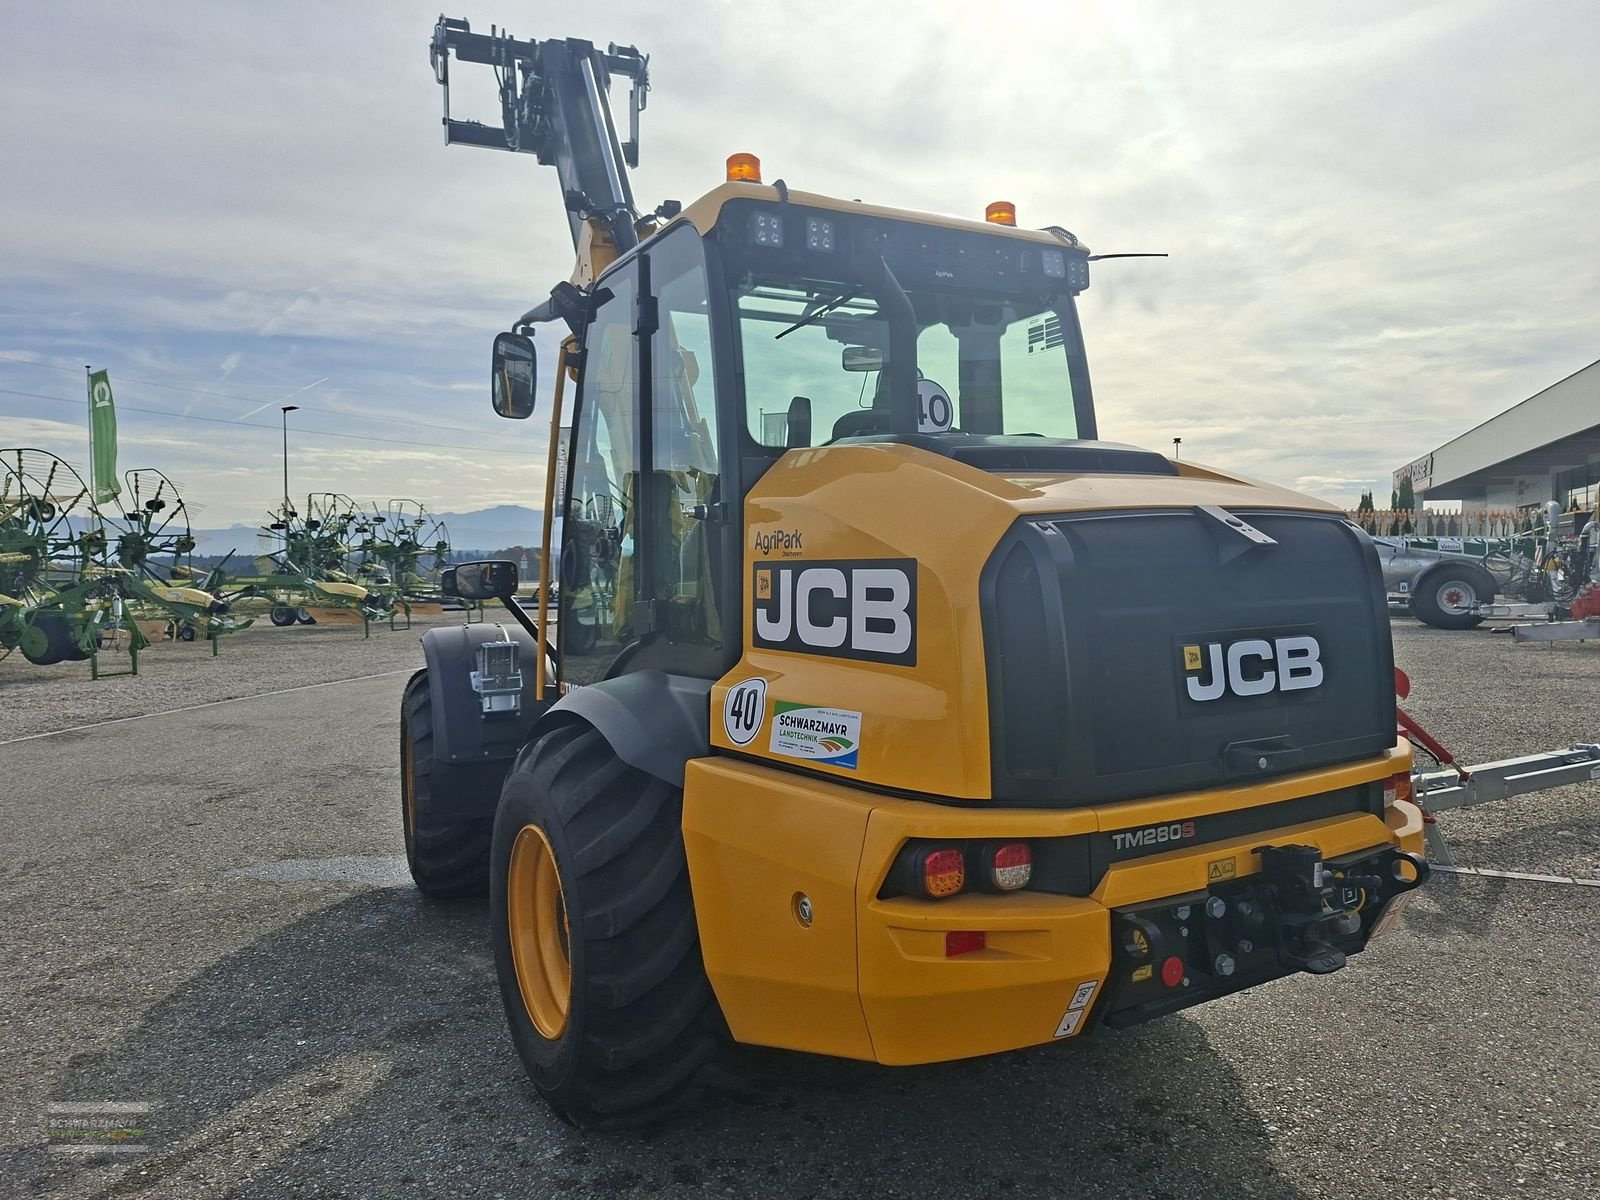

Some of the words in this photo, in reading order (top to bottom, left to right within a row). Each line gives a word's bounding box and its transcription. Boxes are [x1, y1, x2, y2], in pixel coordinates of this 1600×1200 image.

[755, 529, 803, 555] AgriPark
[756, 568, 912, 654] JCB
[1186, 636, 1324, 701] JCB
[731, 688, 758, 731] 40
[779, 714, 848, 736] SCHWARZMAYR
[779, 729, 818, 743] LANDTECHNIK
[1112, 821, 1196, 850] TM280S
